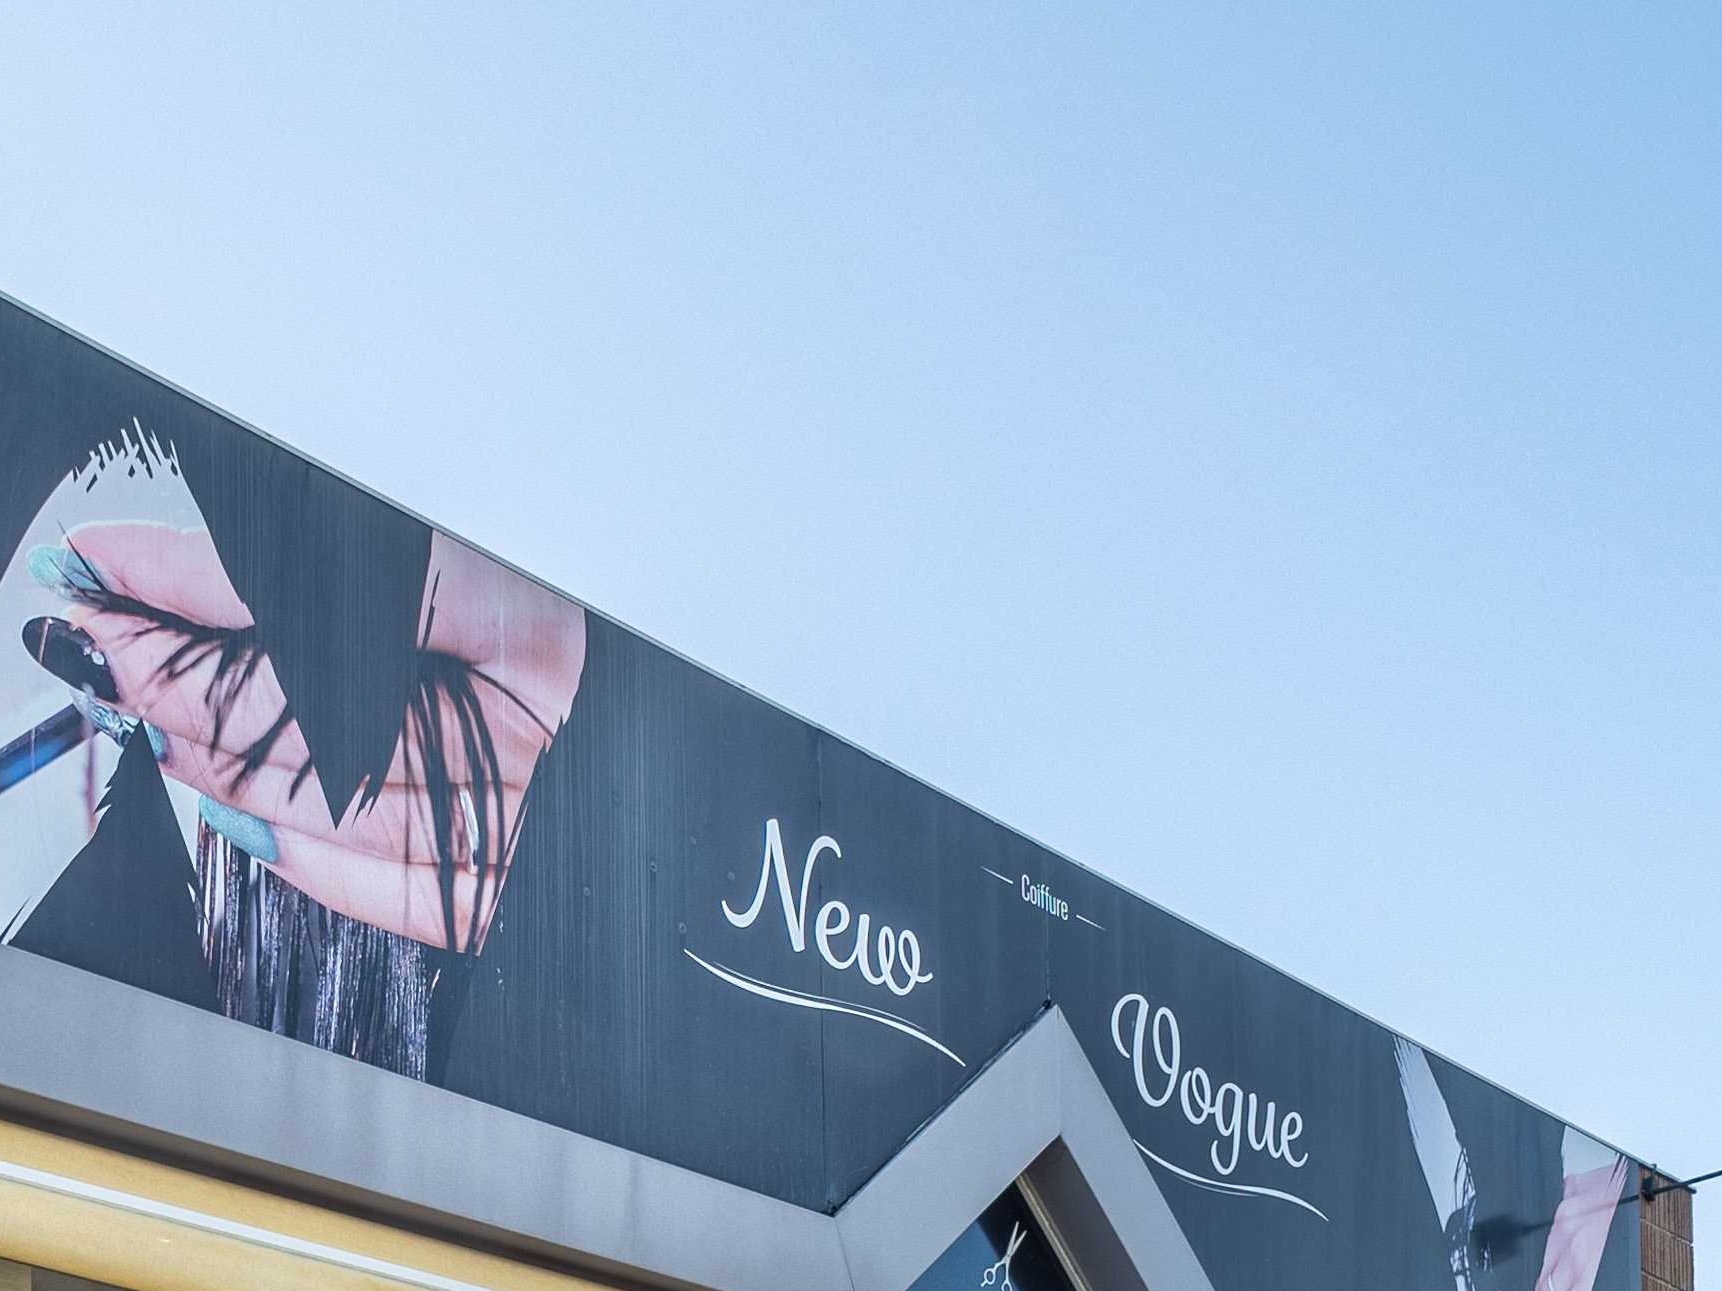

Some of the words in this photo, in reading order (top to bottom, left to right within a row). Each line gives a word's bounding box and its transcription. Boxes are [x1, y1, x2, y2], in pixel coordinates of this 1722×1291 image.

[720, 818, 934, 996] New
[1019, 872, 1070, 922] Coiffure
[1109, 993, 1309, 1176] Vogue
